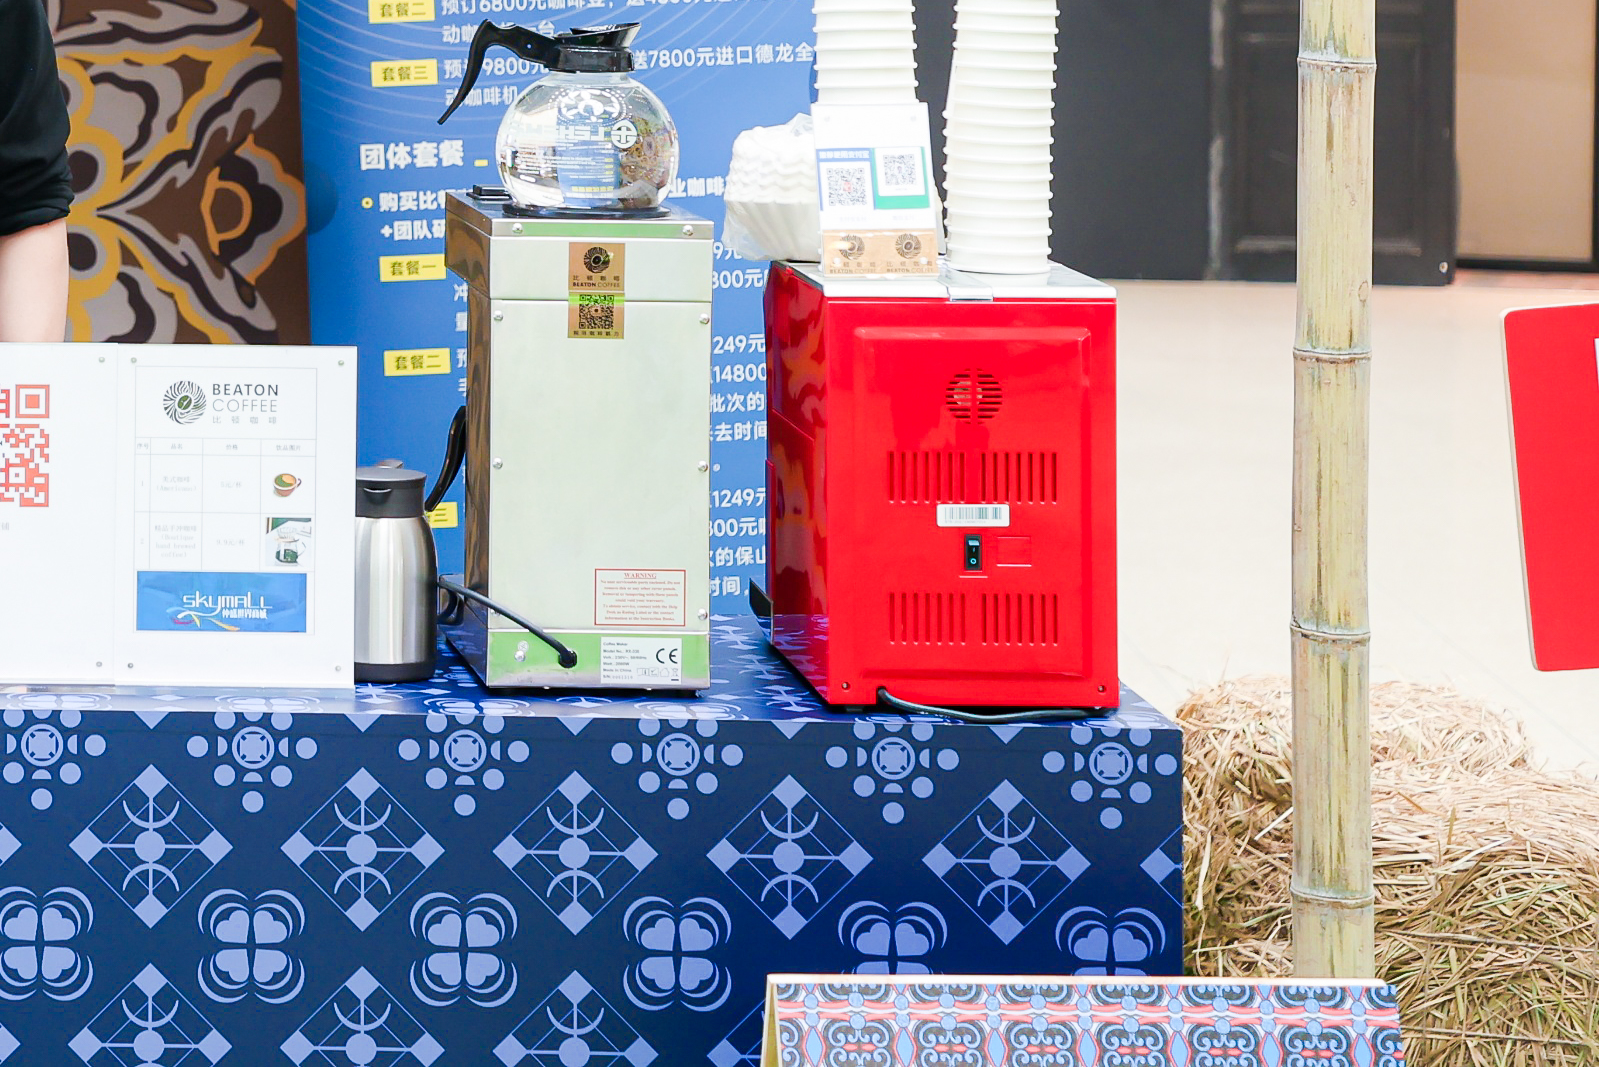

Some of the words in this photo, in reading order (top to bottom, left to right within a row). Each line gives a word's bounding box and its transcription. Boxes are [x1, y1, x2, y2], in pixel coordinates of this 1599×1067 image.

[379, 2, 427, 18] 套餐二
[382, 66, 429, 82] 套餐三
[360, 139, 464, 170] 团体套餐
[391, 261, 436, 275] 套餐一
[395, 354, 441, 371] 套餐二
[710, 363, 766, 383] 14800
[212, 383, 278, 396] BEATON
[212, 399, 277, 413] COFFEE
[710, 420, 767, 442] 去时间
[710, 487, 765, 508] 1249元
